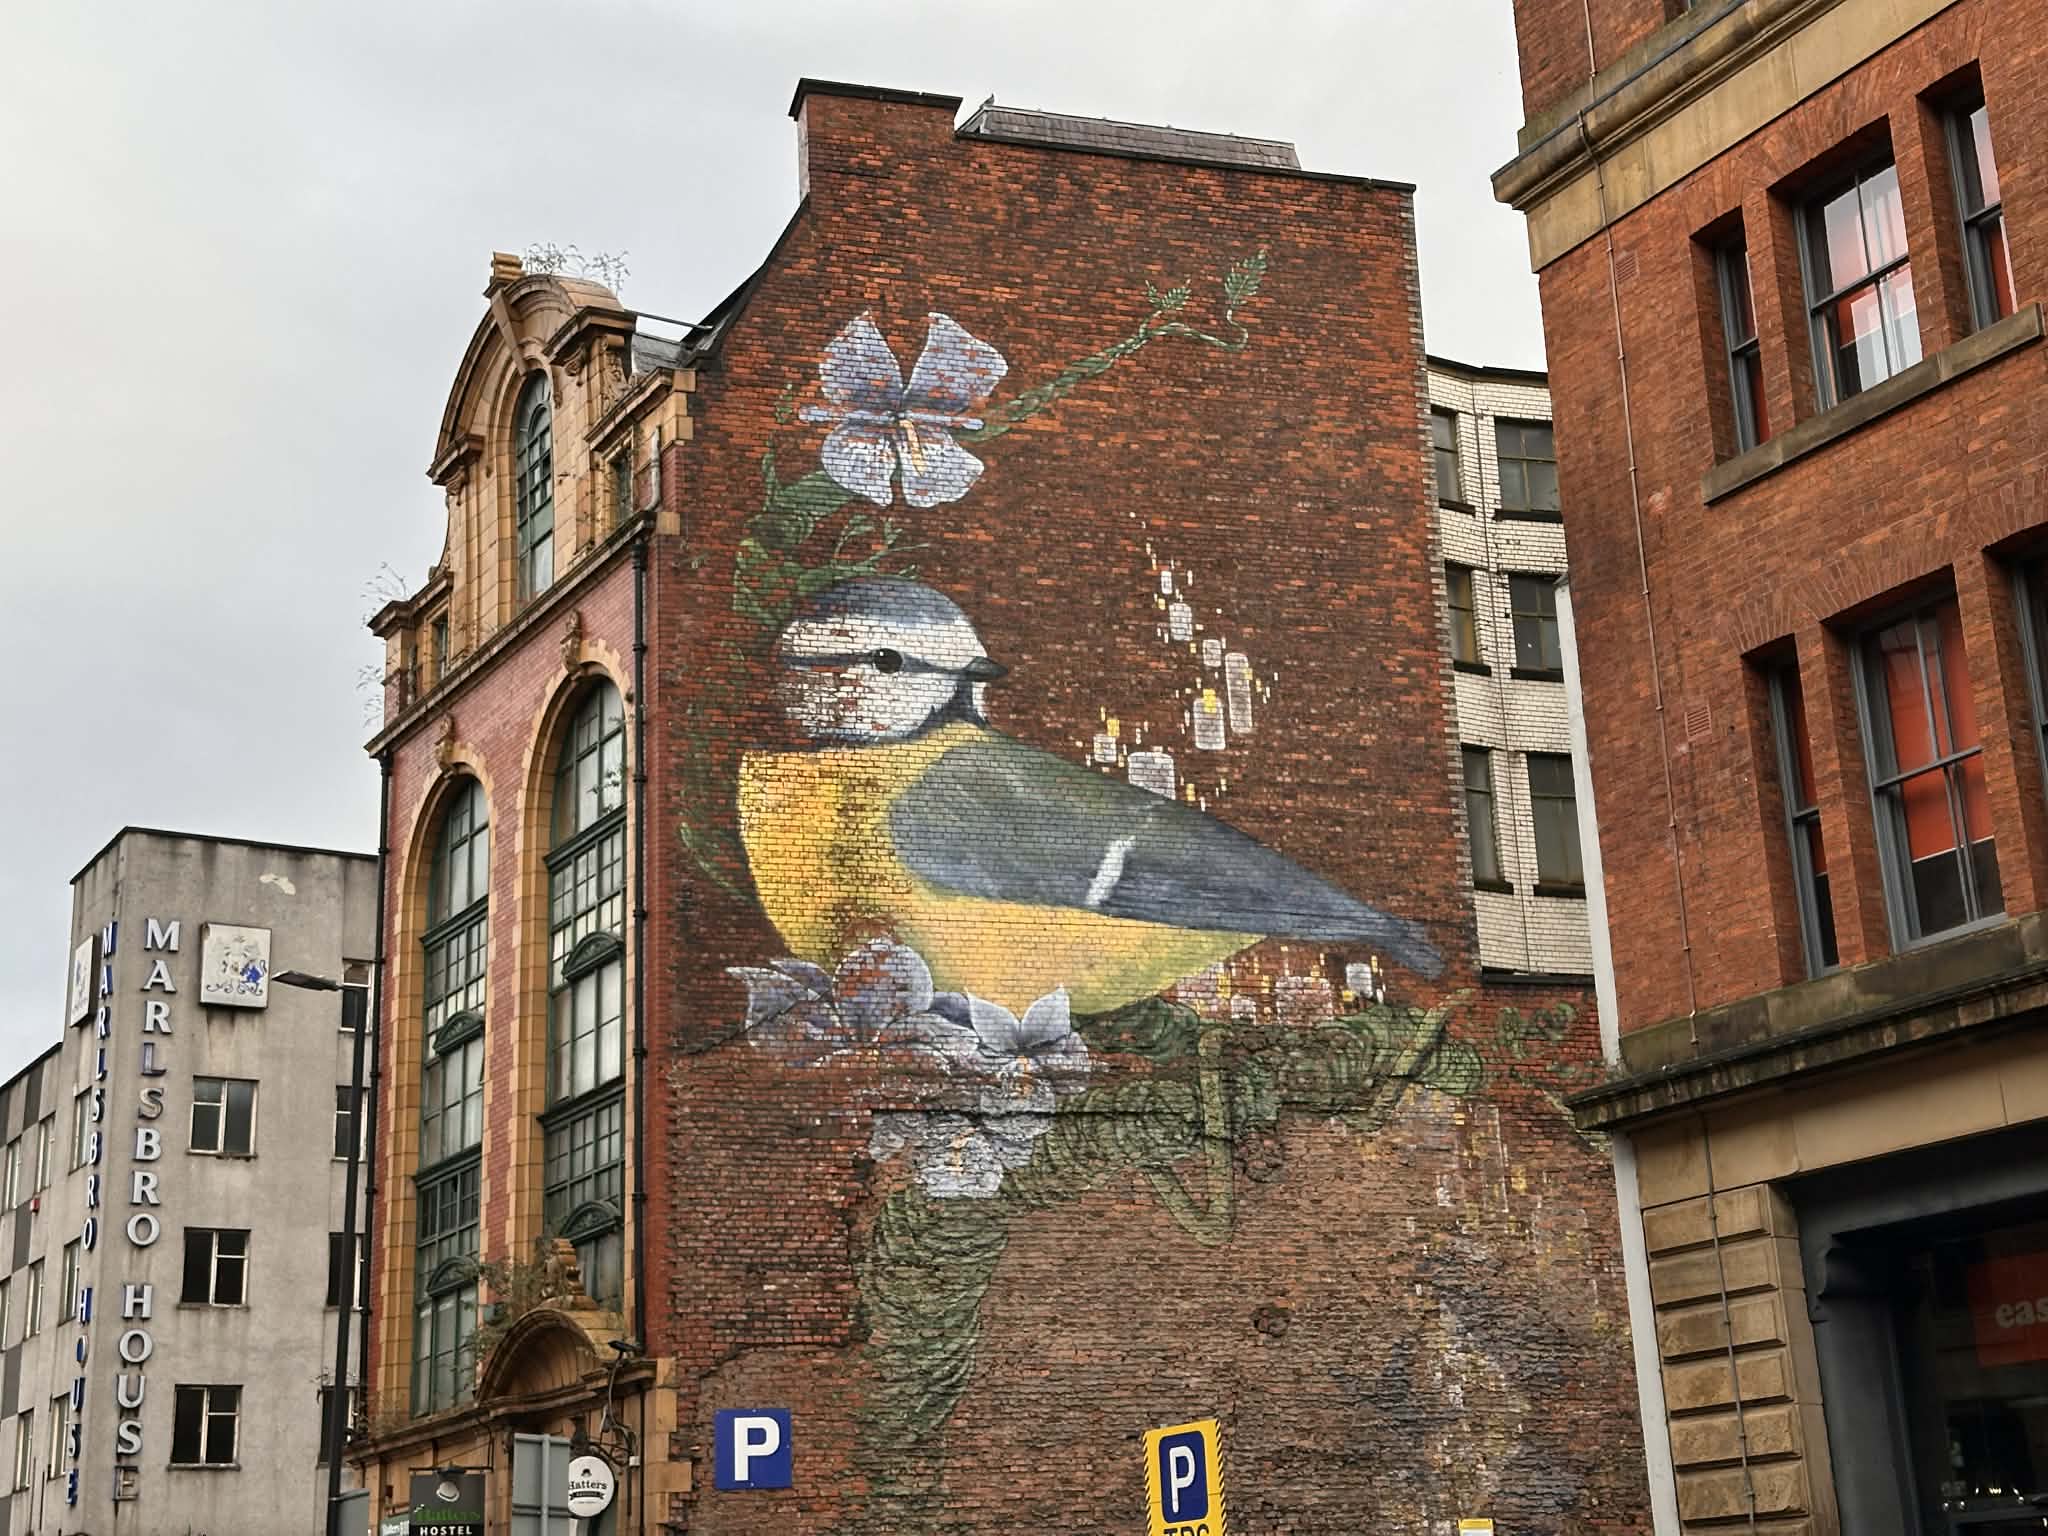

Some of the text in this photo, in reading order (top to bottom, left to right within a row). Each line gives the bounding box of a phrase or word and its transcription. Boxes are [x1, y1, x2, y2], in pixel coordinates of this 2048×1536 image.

[66, 920, 118, 1505] MARLSBRO HOUSE
[113, 918, 181, 1502] MARLSBRO HOUSE
[734, 1416, 780, 1481] P
[1169, 1445, 1196, 1513] P
[420, 1526, 472, 1536] HOSTEL
